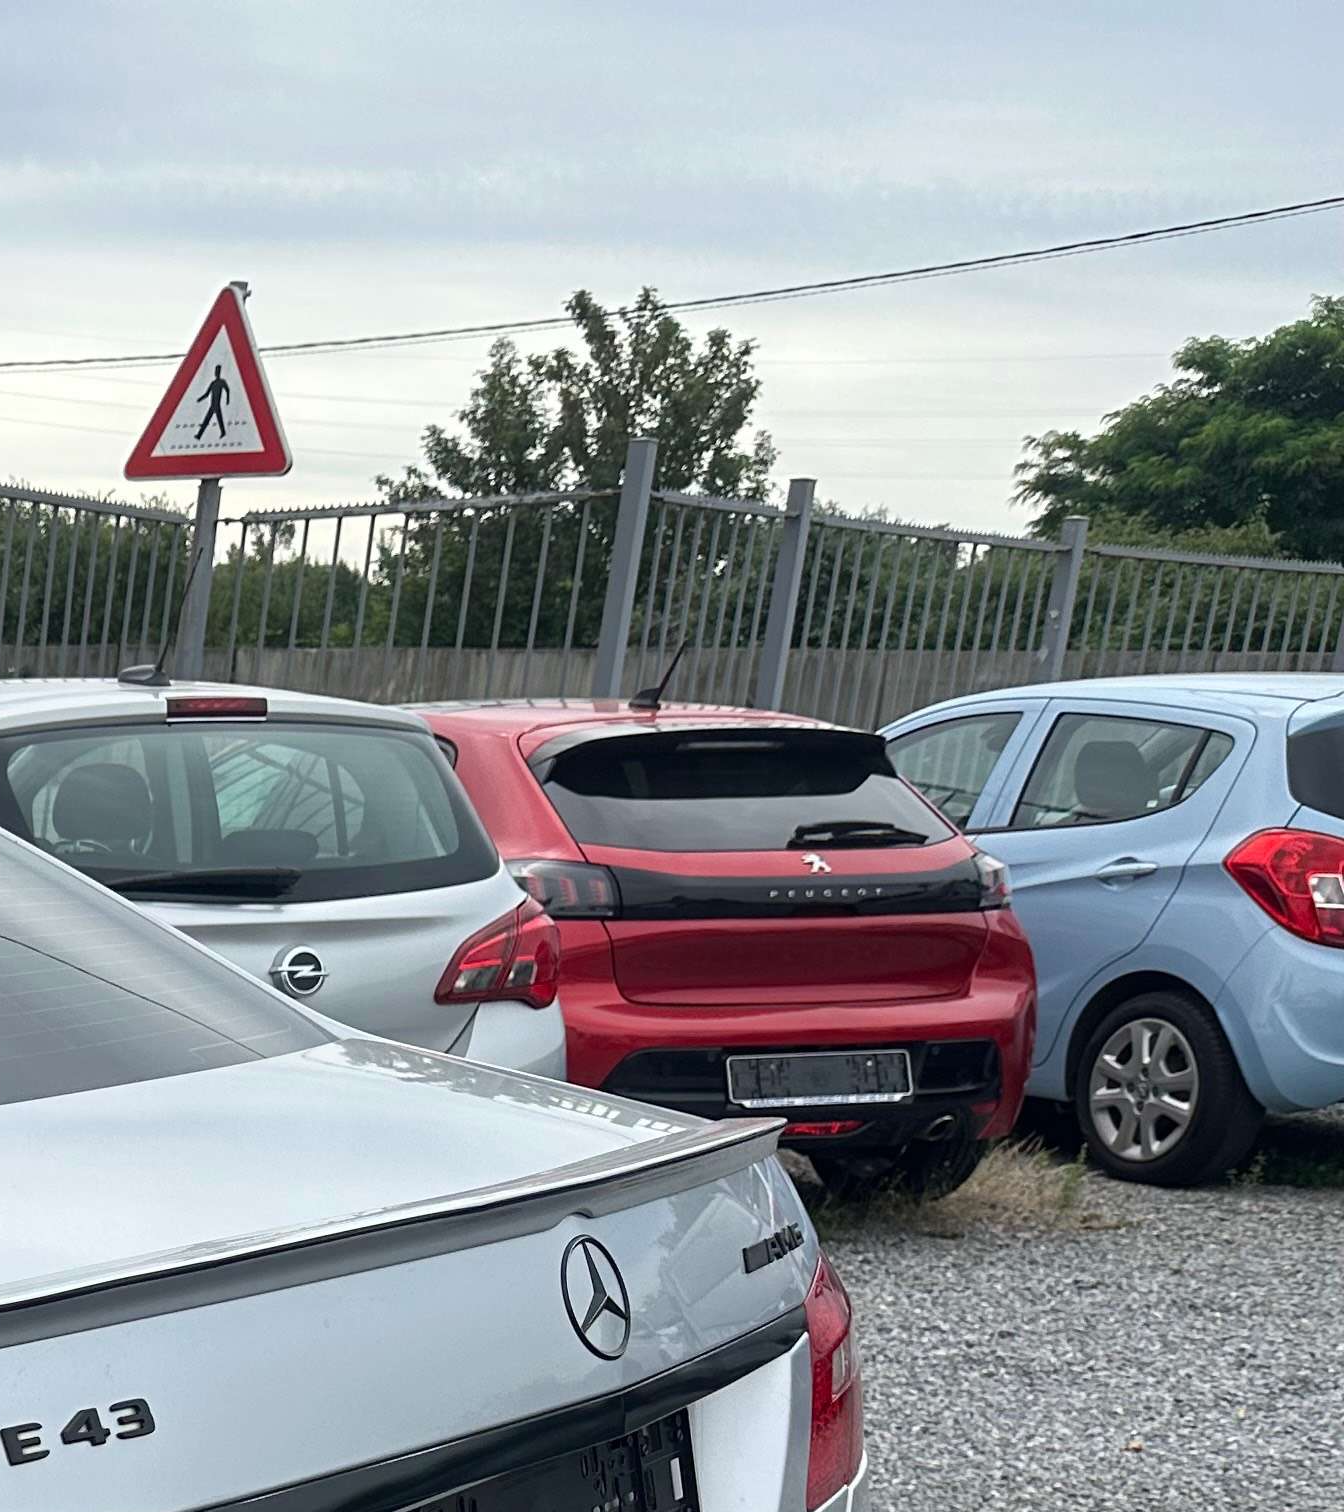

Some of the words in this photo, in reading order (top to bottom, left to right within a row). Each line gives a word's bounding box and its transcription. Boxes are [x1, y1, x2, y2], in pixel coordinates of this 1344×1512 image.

[769, 886, 884, 898] PEUGEOT
[0, 1422, 51, 1467] E
[60, 1398, 156, 1446] 43
